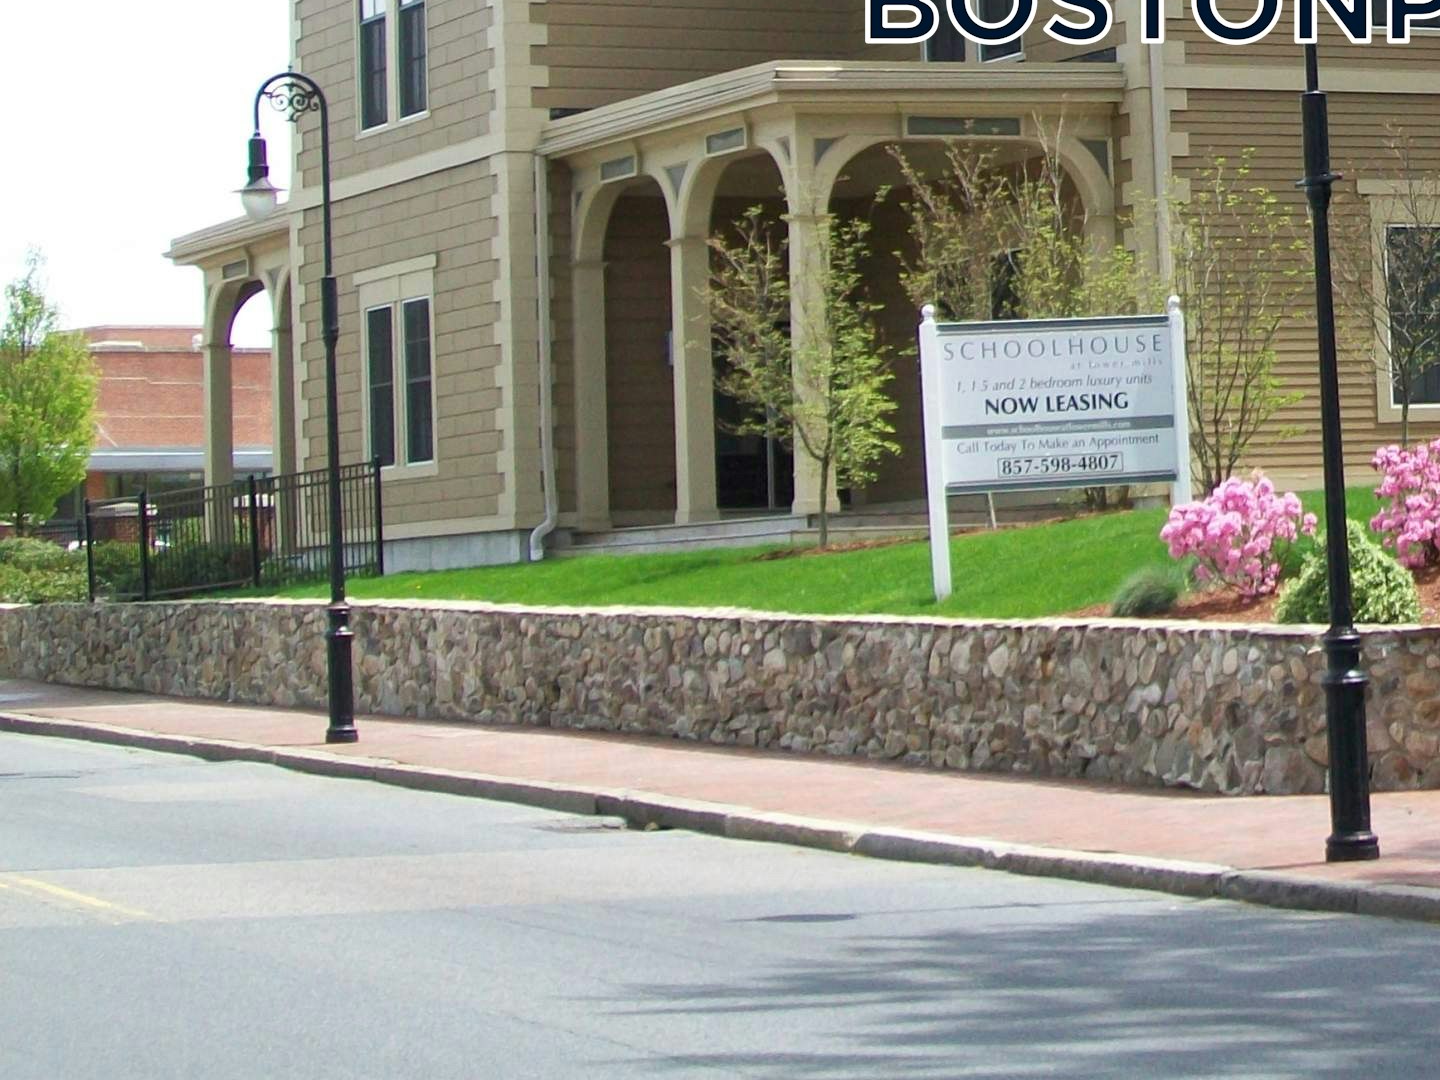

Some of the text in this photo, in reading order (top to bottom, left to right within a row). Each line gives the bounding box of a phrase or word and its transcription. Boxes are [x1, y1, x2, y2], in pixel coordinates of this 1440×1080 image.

[943, 333, 1163, 362] SCHOOLHOUSE
[992, 377, 1016, 391] and
[1018, 378, 1026, 390] 2
[1029, 376, 1083, 389] bedroom
[1086, 374, 1121, 388] luxury
[1125, 373, 1153, 385] units
[985, 391, 1129, 415] NOW LEASING
[957, 433, 1159, 454] Call Today To Make an Appointment
[1002, 454, 1119, 476] 857-598-4807
